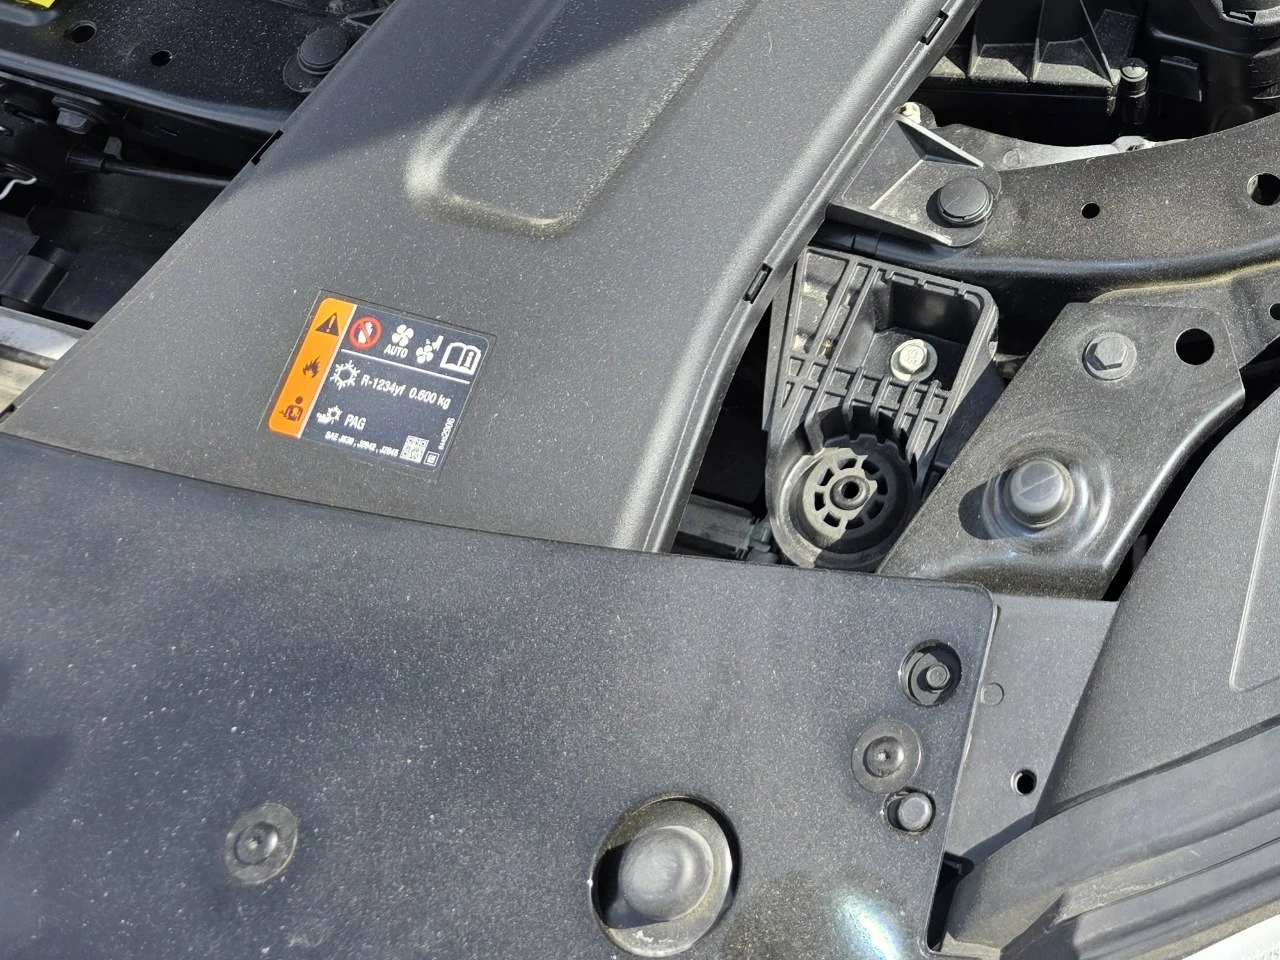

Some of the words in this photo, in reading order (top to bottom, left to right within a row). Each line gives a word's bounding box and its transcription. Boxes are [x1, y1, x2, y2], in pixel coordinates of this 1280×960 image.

[384, 344, 408, 358] AUTO
[361, 374, 406, 397] R-1234yf
[409, 387, 437, 404] 0.600
[437, 394, 452, 410] kg
[344, 414, 367, 431] PAG
